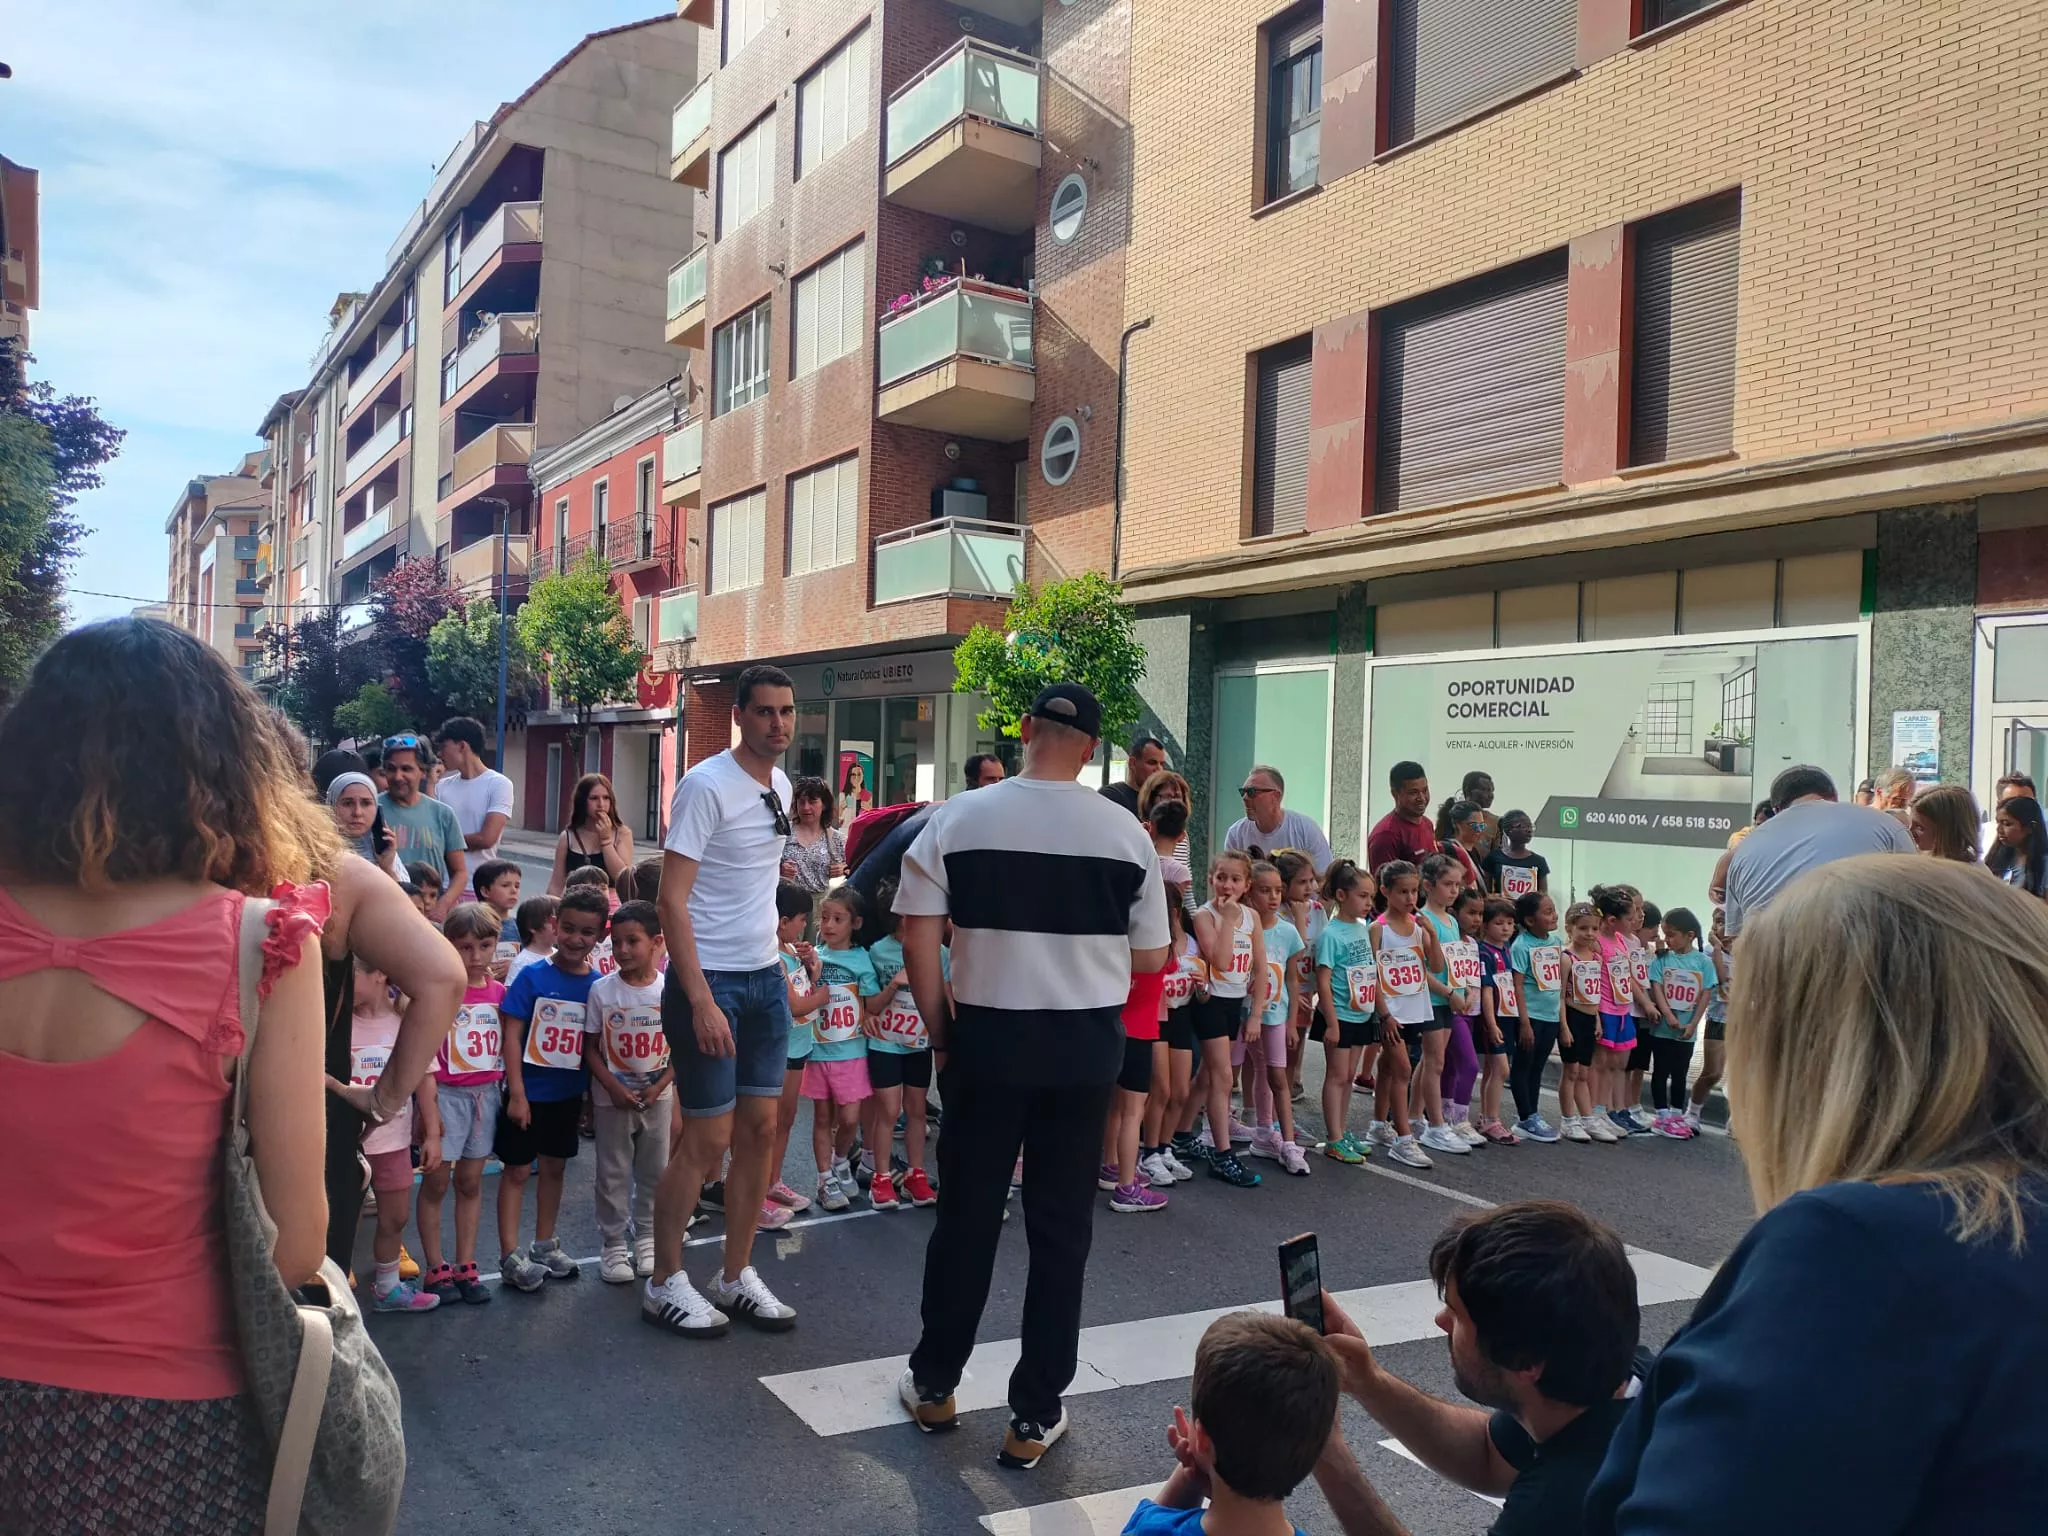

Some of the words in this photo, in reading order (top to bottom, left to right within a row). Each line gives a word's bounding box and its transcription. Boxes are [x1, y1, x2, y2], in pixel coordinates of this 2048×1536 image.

[837, 668, 859, 682] Natural
[860, 668, 880, 682] Optics
[882, 664, 914, 678] UBIETO
[1447, 676, 1575, 697] OPORTUNIDAD
[1447, 700, 1550, 718] COMERCIAL
[1446, 740, 1472, 750] VENTA
[1479, 740, 1518, 750] ALQUILER
[1525, 738, 1574, 750] INVERSIÓN
[1586, 812, 1606, 824] 620
[1608, 813, 1627, 825] 410
[1629, 814, 1648, 826] 014
[1661, 816, 1683, 828] 658
[1685, 817, 1706, 829] 518
[1708, 818, 1731, 830] 530
[1508, 880, 1532, 895] 502
[1389, 965, 1422, 986] 335
[1584, 978, 1601, 995] 32
[1666, 984, 1696, 1003] 306
[820, 1005, 855, 1031] 346
[881, 1009, 919, 1036] 322
[467, 1030, 499, 1057] 312
[618, 1032, 663, 1058] 384
